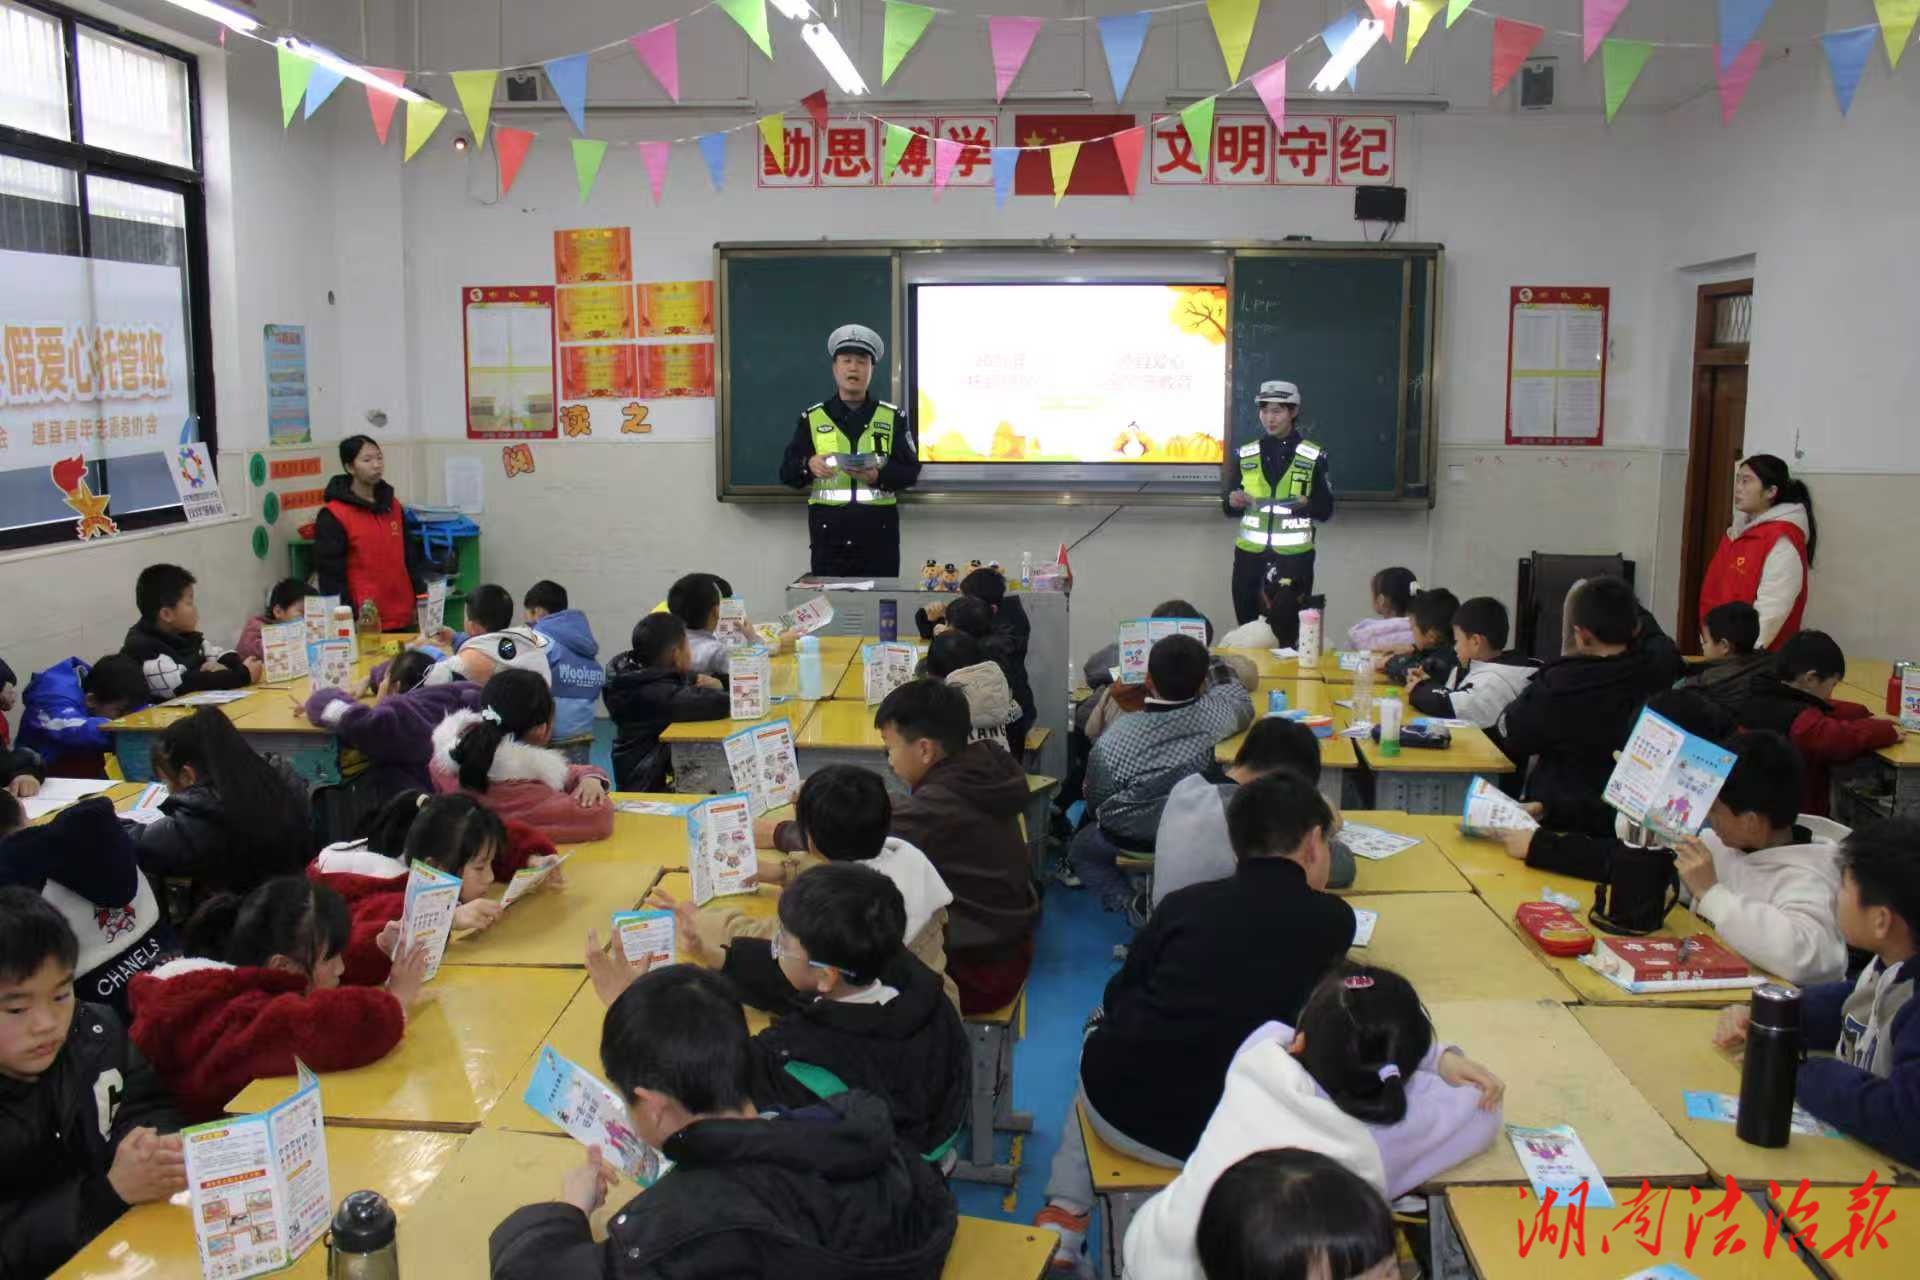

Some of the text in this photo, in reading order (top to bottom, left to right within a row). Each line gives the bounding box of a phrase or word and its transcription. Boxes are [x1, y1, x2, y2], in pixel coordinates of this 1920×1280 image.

[1156, 124, 1389, 177] 文明守纪
[0, 324, 168, 396] 假爱心托管班
[97, 937, 160, 996] CHANELS
